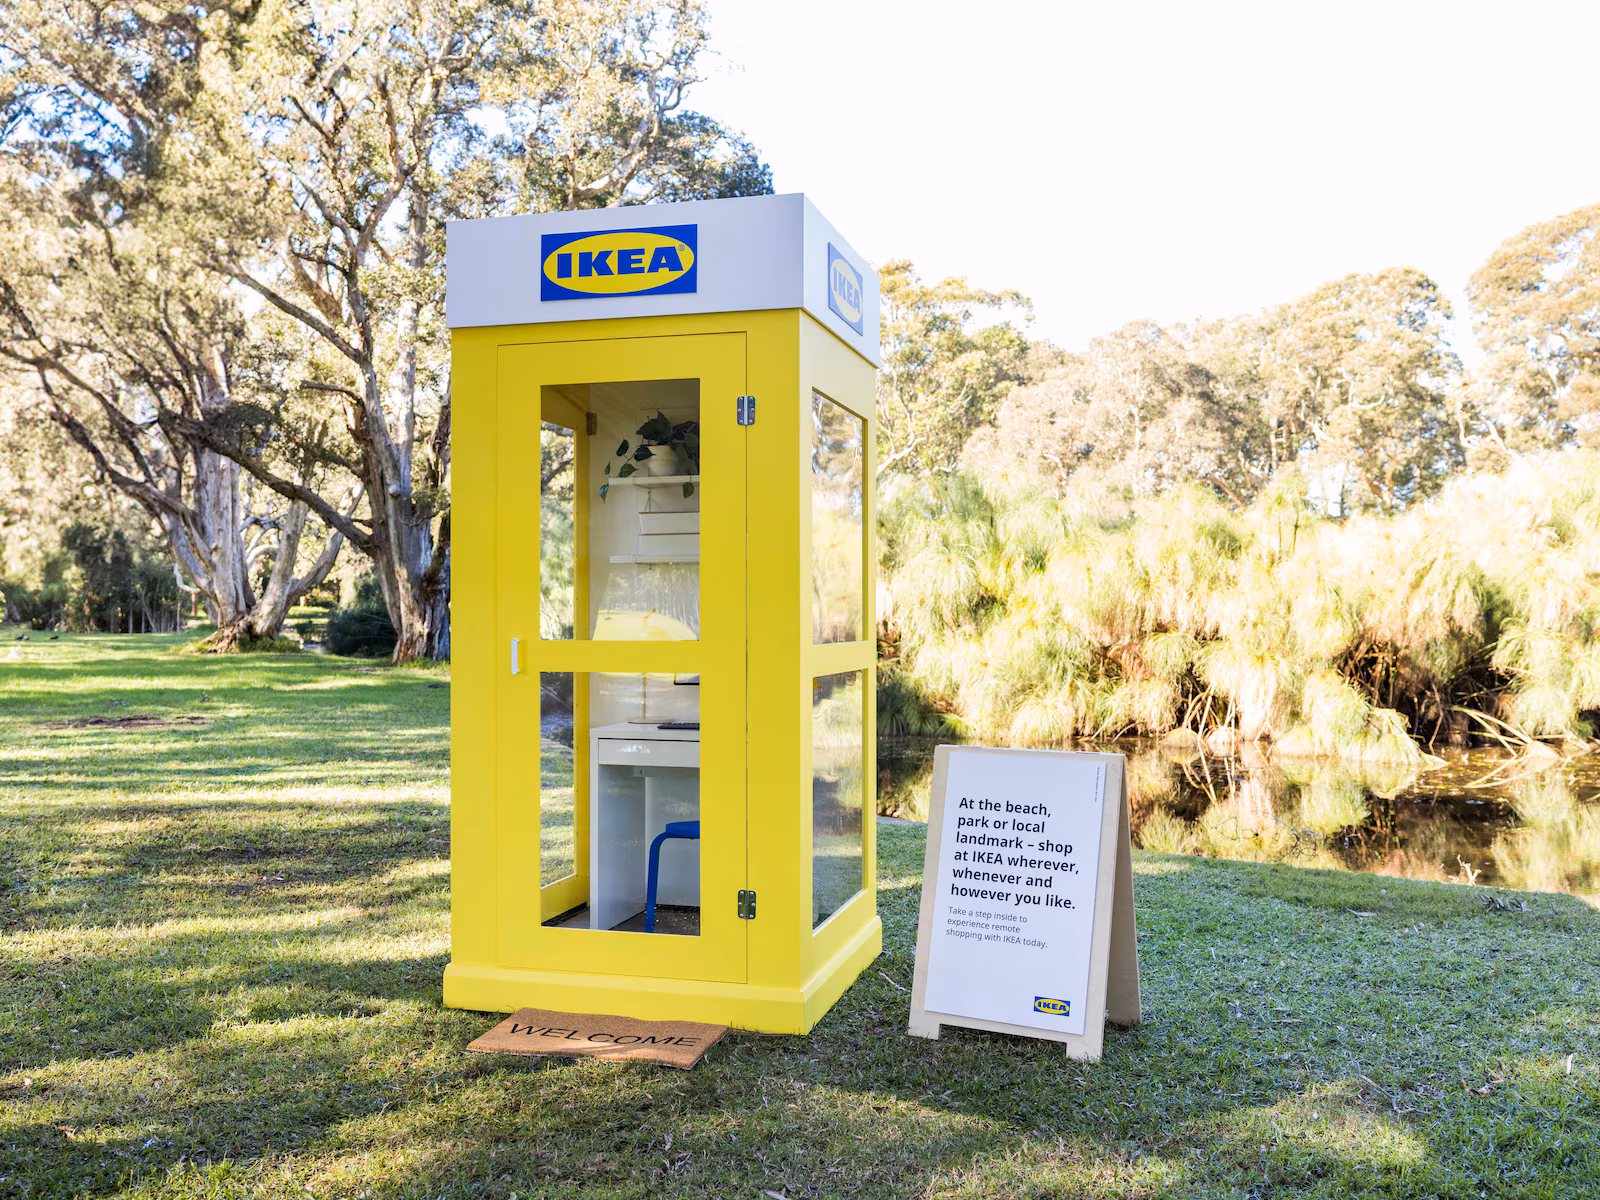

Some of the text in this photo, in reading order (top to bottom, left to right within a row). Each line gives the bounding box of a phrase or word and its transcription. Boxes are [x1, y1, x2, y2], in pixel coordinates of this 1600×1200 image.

[833, 266, 861, 314] IKEA
[958, 797, 1051, 818] At the beach,
[957, 815, 1045, 834] park or local
[956, 831, 1024, 850] landmark
[1038, 839, 1073, 857] shop
[954, 850, 1079, 875] at IKEA wherever,
[952, 867, 1053, 889] whenever and
[950, 883, 1076, 910] however you like.
[948, 906, 967, 916] Take
[975, 910, 992, 921] step
[993, 913, 1018, 922] inside
[1019, 915, 1028, 923] to
[947, 918, 1021, 934] experience remote
[946, 927, 1048, 950] shopping with IKEA today.
[1038, 1001, 1067, 1011] IKEA
[510, 1023, 702, 1047] WELCOME
